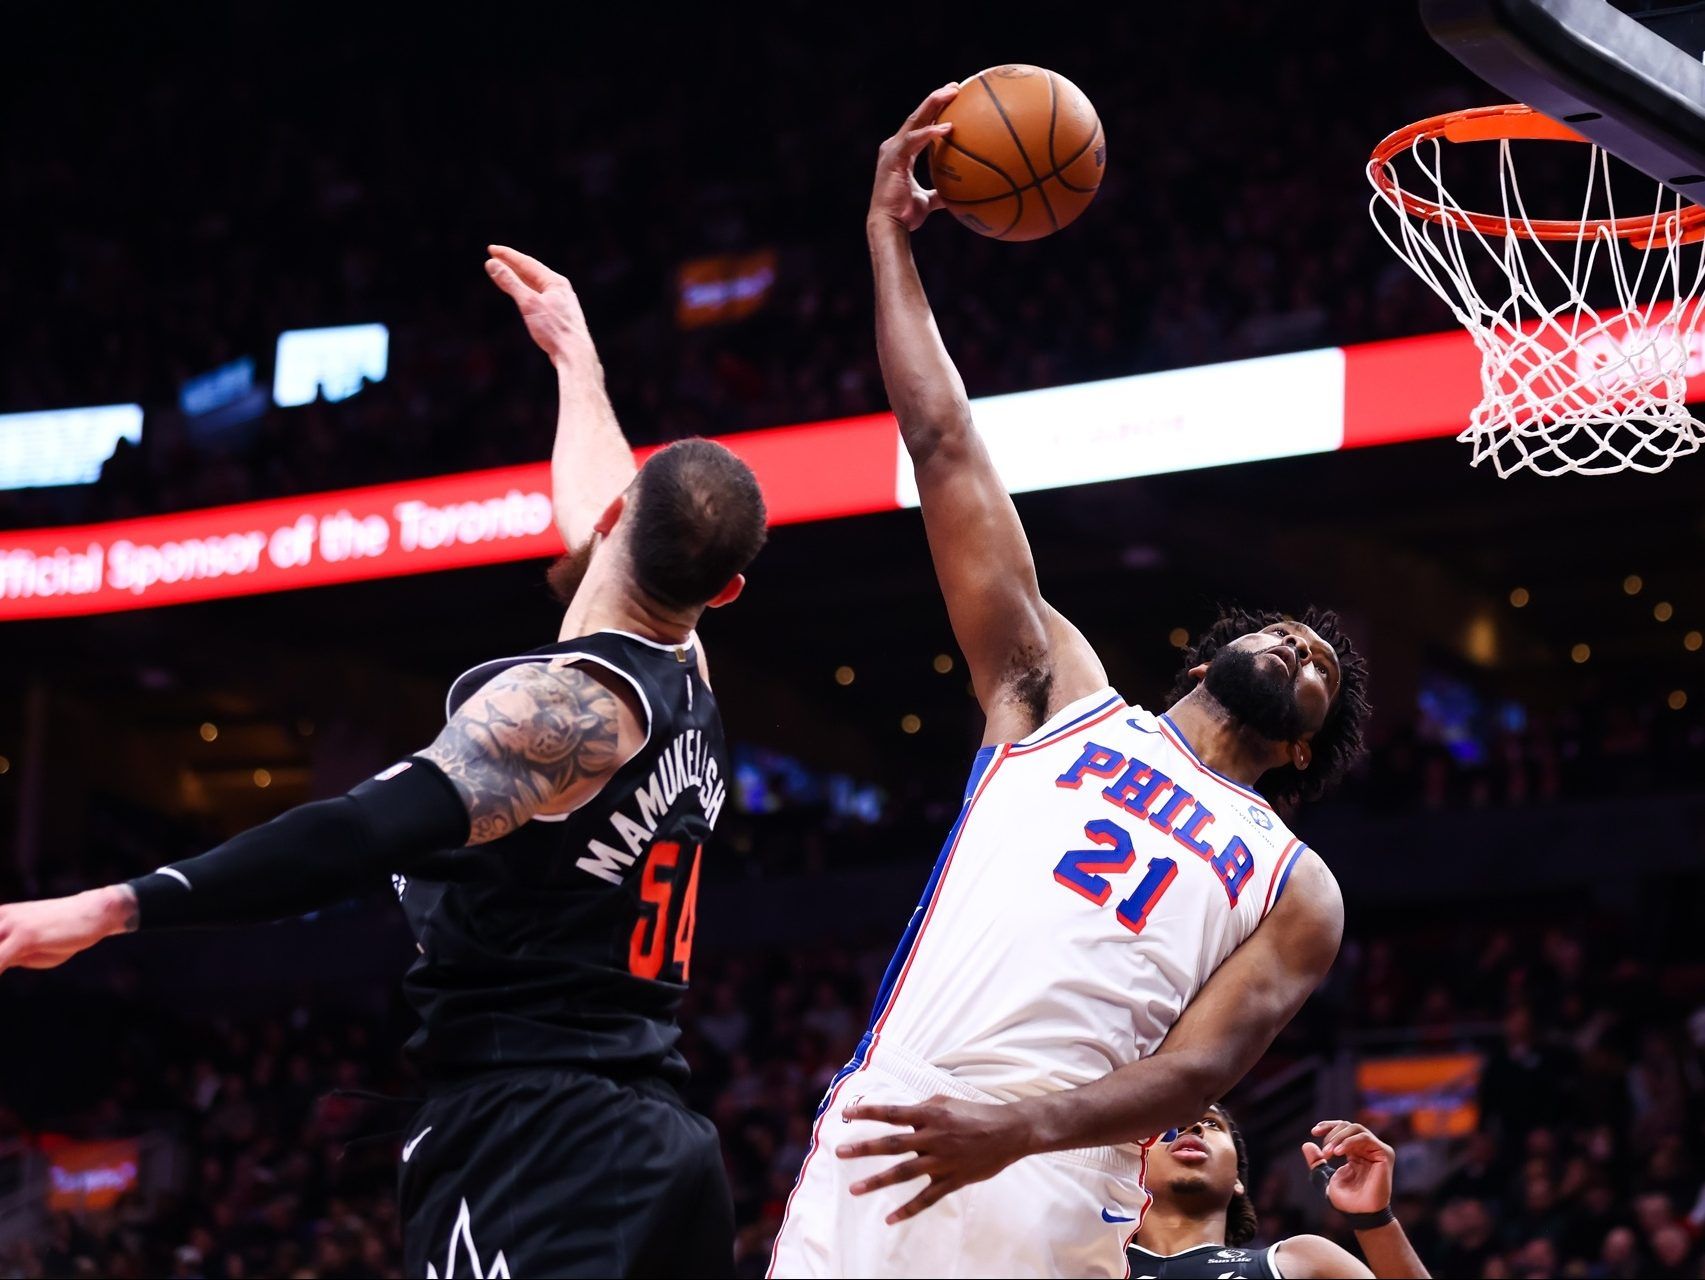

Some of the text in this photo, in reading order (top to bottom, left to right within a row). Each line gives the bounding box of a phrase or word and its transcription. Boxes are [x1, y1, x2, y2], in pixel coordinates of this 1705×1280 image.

[107, 539, 267, 595] Sponsor
[268, 514, 317, 568] of
[319, 509, 390, 562] the
[393, 489, 552, 551] Toronto
[575, 729, 726, 885] MAMUKELSH
[1053, 818, 1178, 936] 21
[1055, 741, 1254, 910] PHILA
[628, 841, 702, 985] 54
